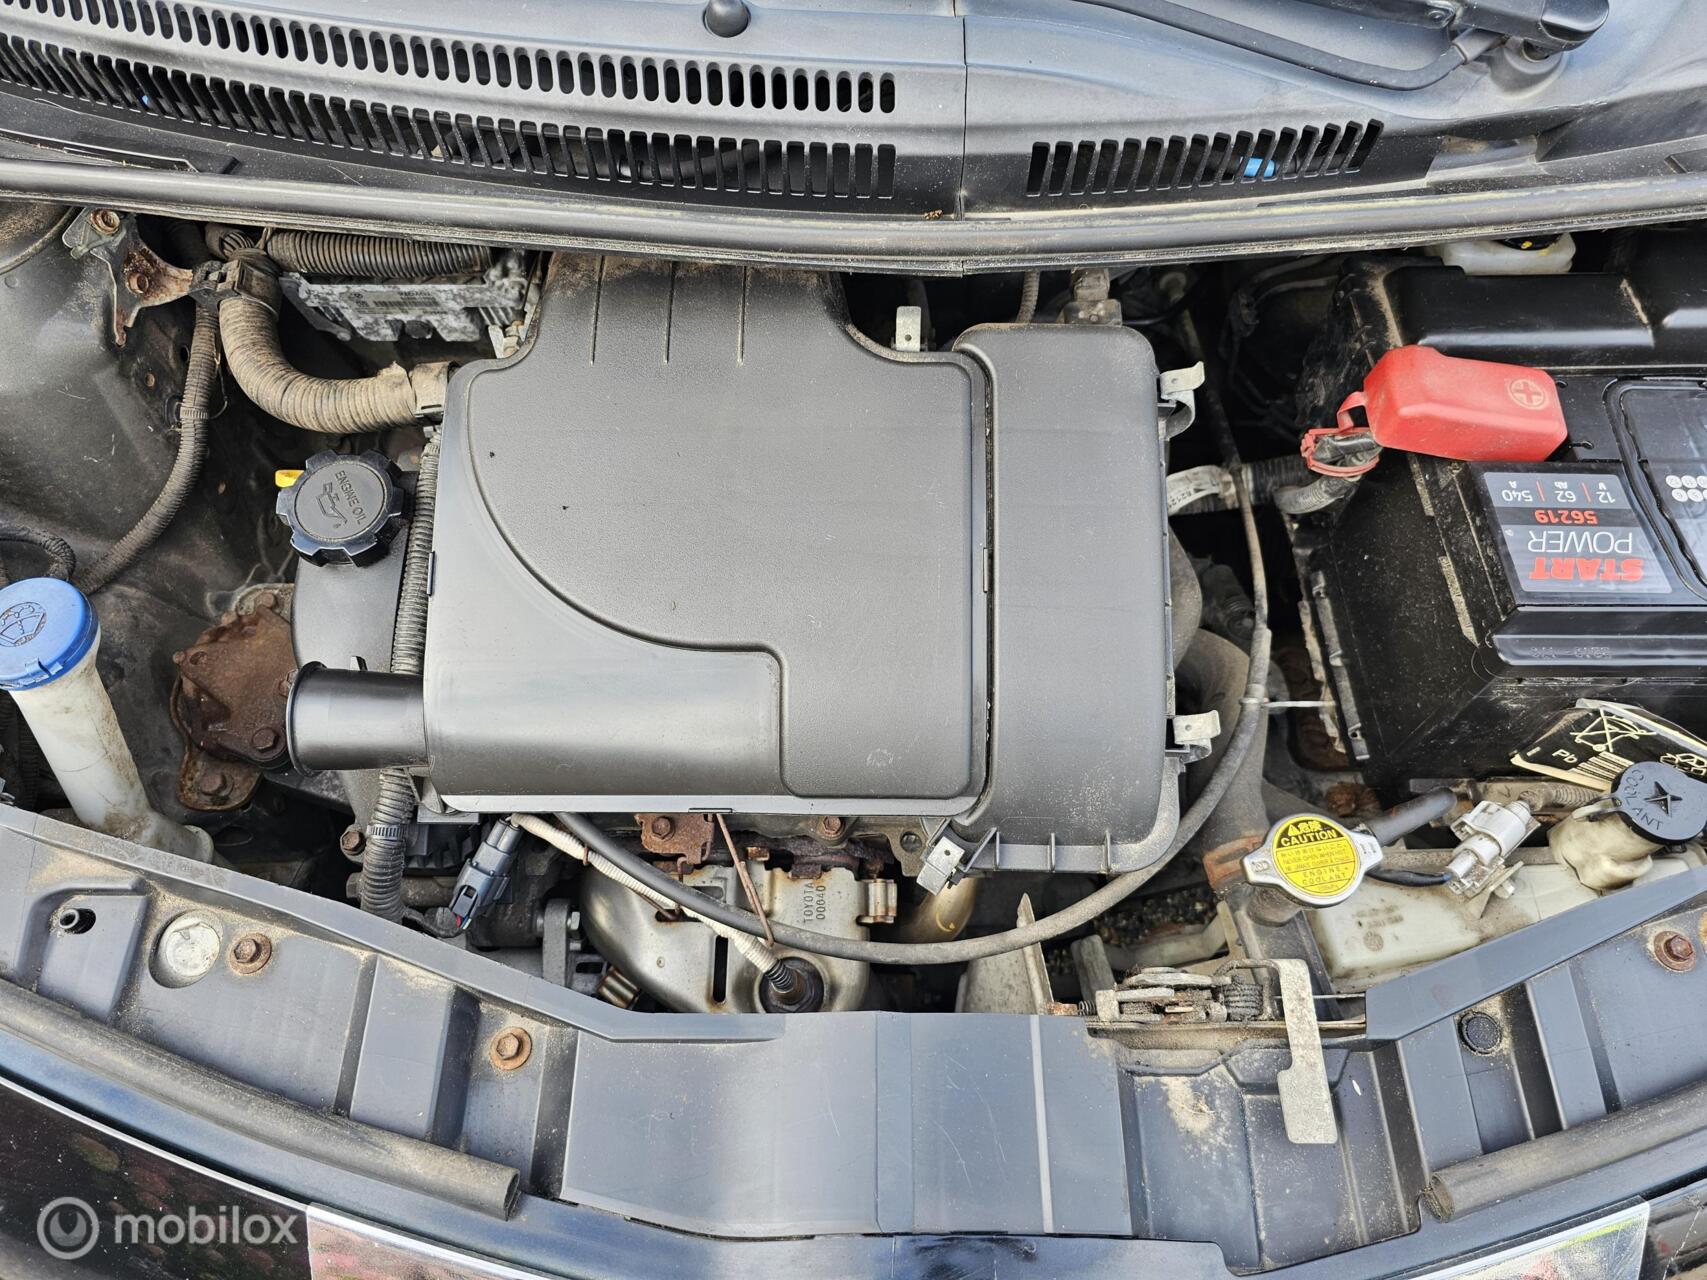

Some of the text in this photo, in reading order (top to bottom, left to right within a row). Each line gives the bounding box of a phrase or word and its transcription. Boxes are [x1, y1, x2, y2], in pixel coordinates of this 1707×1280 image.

[335, 470, 367, 525] ENGINE OIL
[1501, 489, 1533, 502] 540
[1554, 490, 1577, 502] 62
[1595, 491, 1616, 504] 12
[1534, 509, 1598, 524] 56219
[1527, 530, 1633, 554] POWER
[1528, 556, 1645, 582] START
[1552, 749, 1578, 764] Pb
[1624, 769, 1664, 830] COOLANT
[1280, 829, 1338, 848] CAUTION
[1302, 873, 1347, 885] COOLANT
[1303, 866, 1341, 878] ENGINE
[803, 882, 815, 923] TOYOTA
